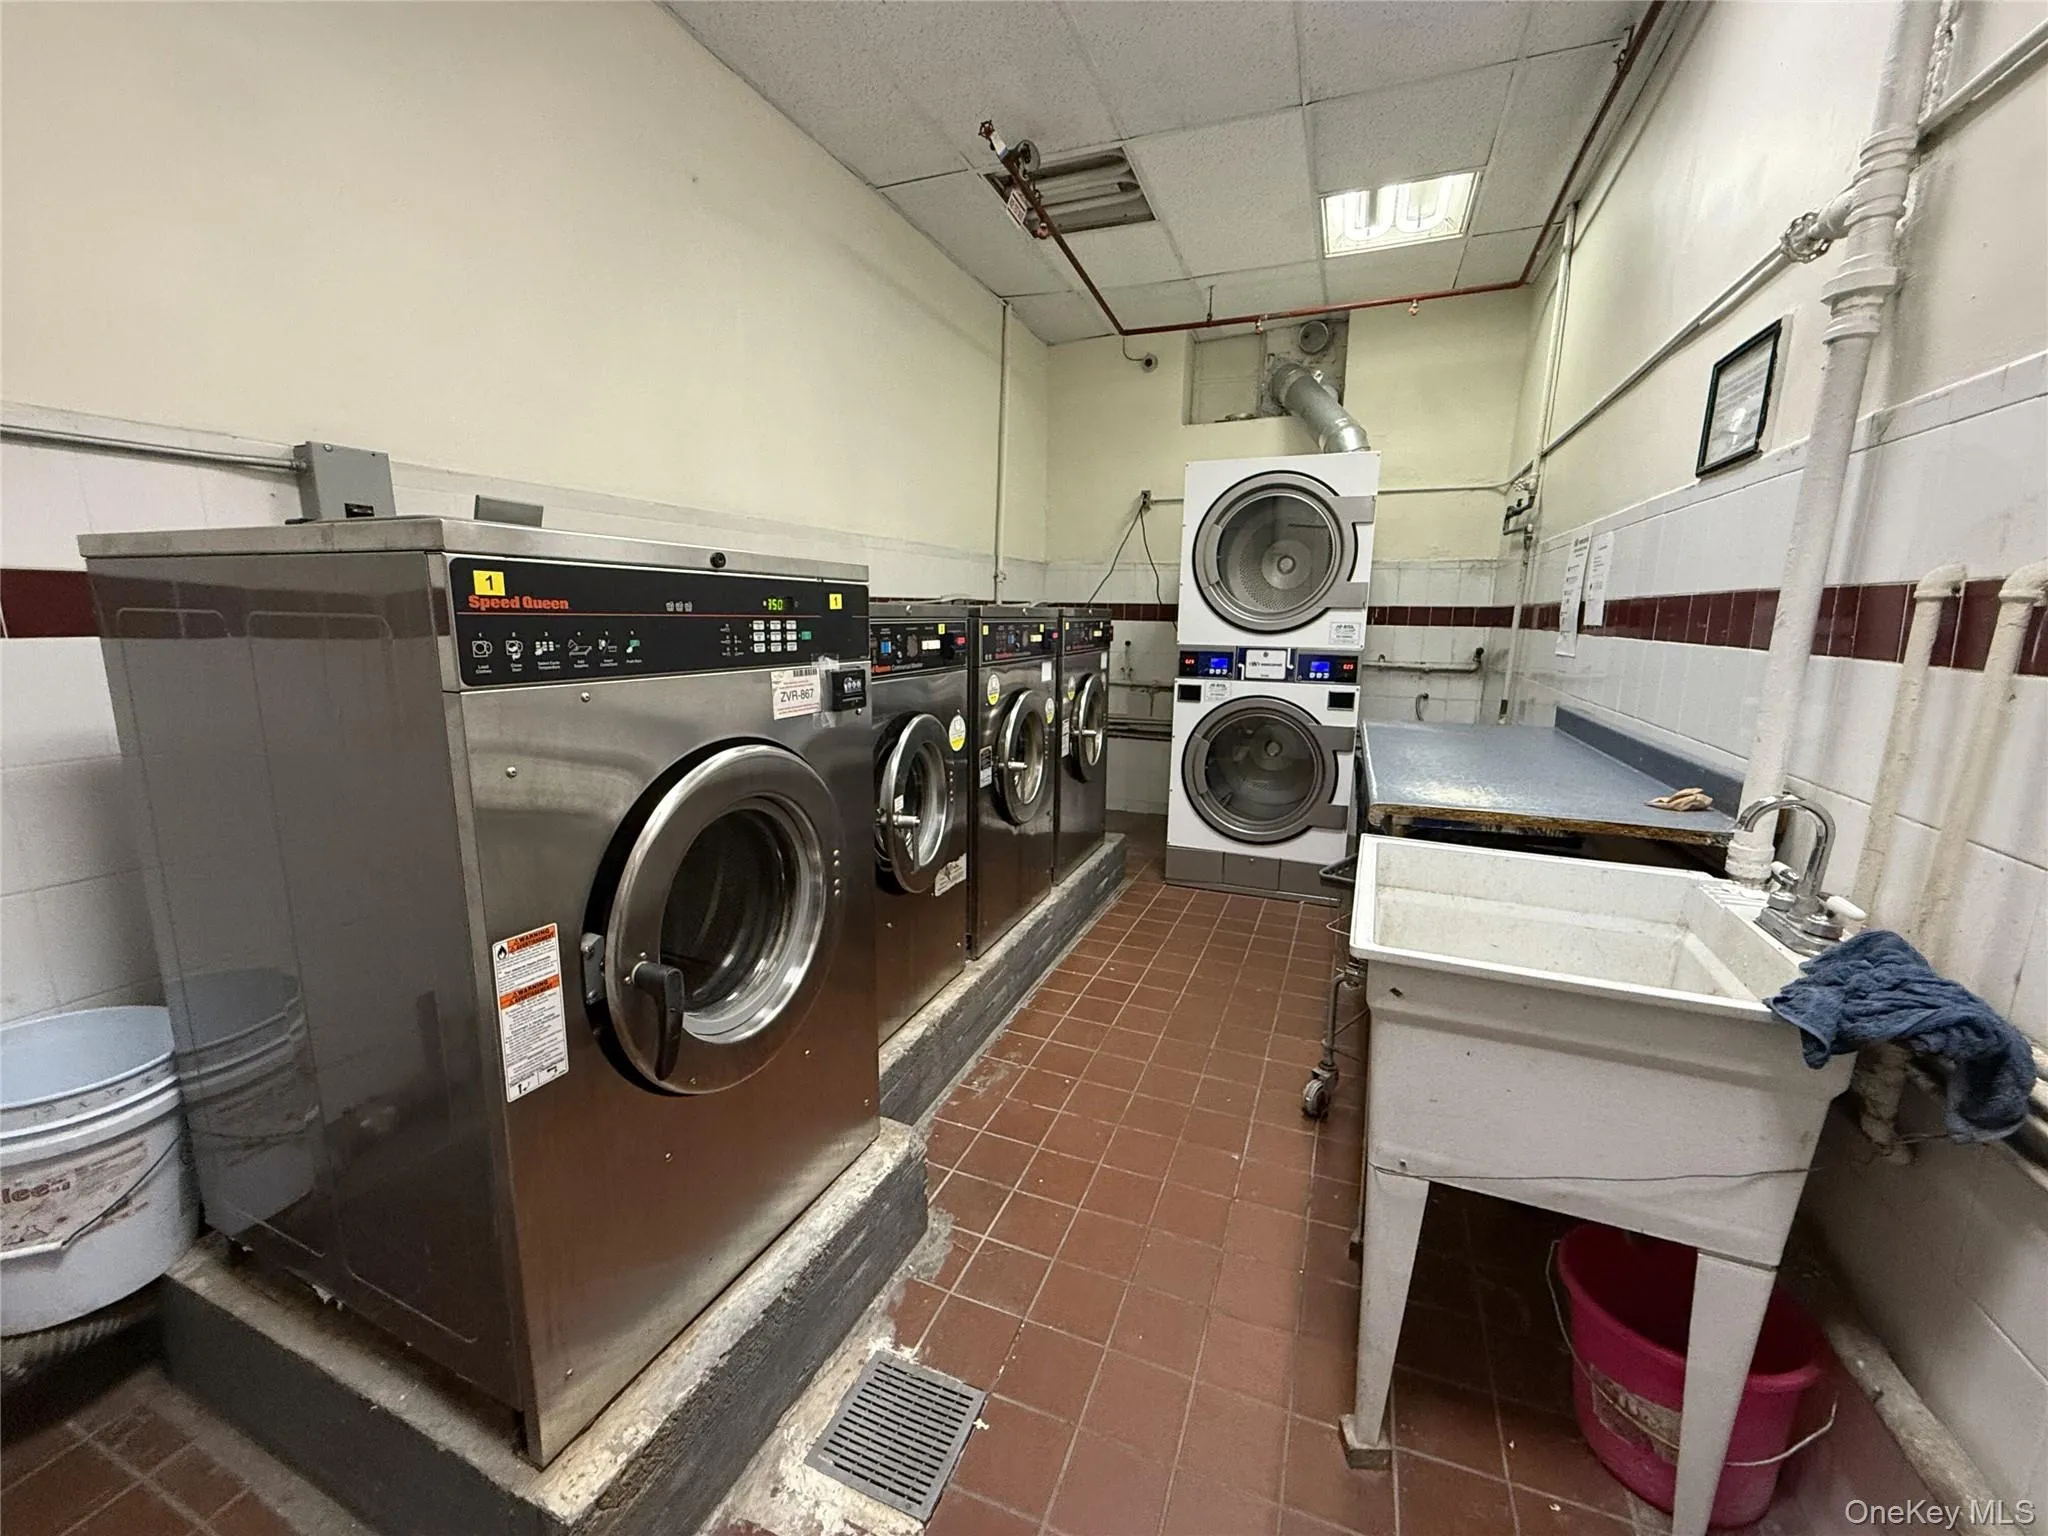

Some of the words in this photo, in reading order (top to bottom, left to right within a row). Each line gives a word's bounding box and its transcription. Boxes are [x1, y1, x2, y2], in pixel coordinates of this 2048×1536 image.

[485, 575, 494, 591] 1
[468, 595, 520, 610] Speed
[522, 597, 569, 610] Queen
[780, 688, 814, 703] ZVR-867
[518, 928, 549, 942] WARNING
[518, 979, 548, 993] WARNING
